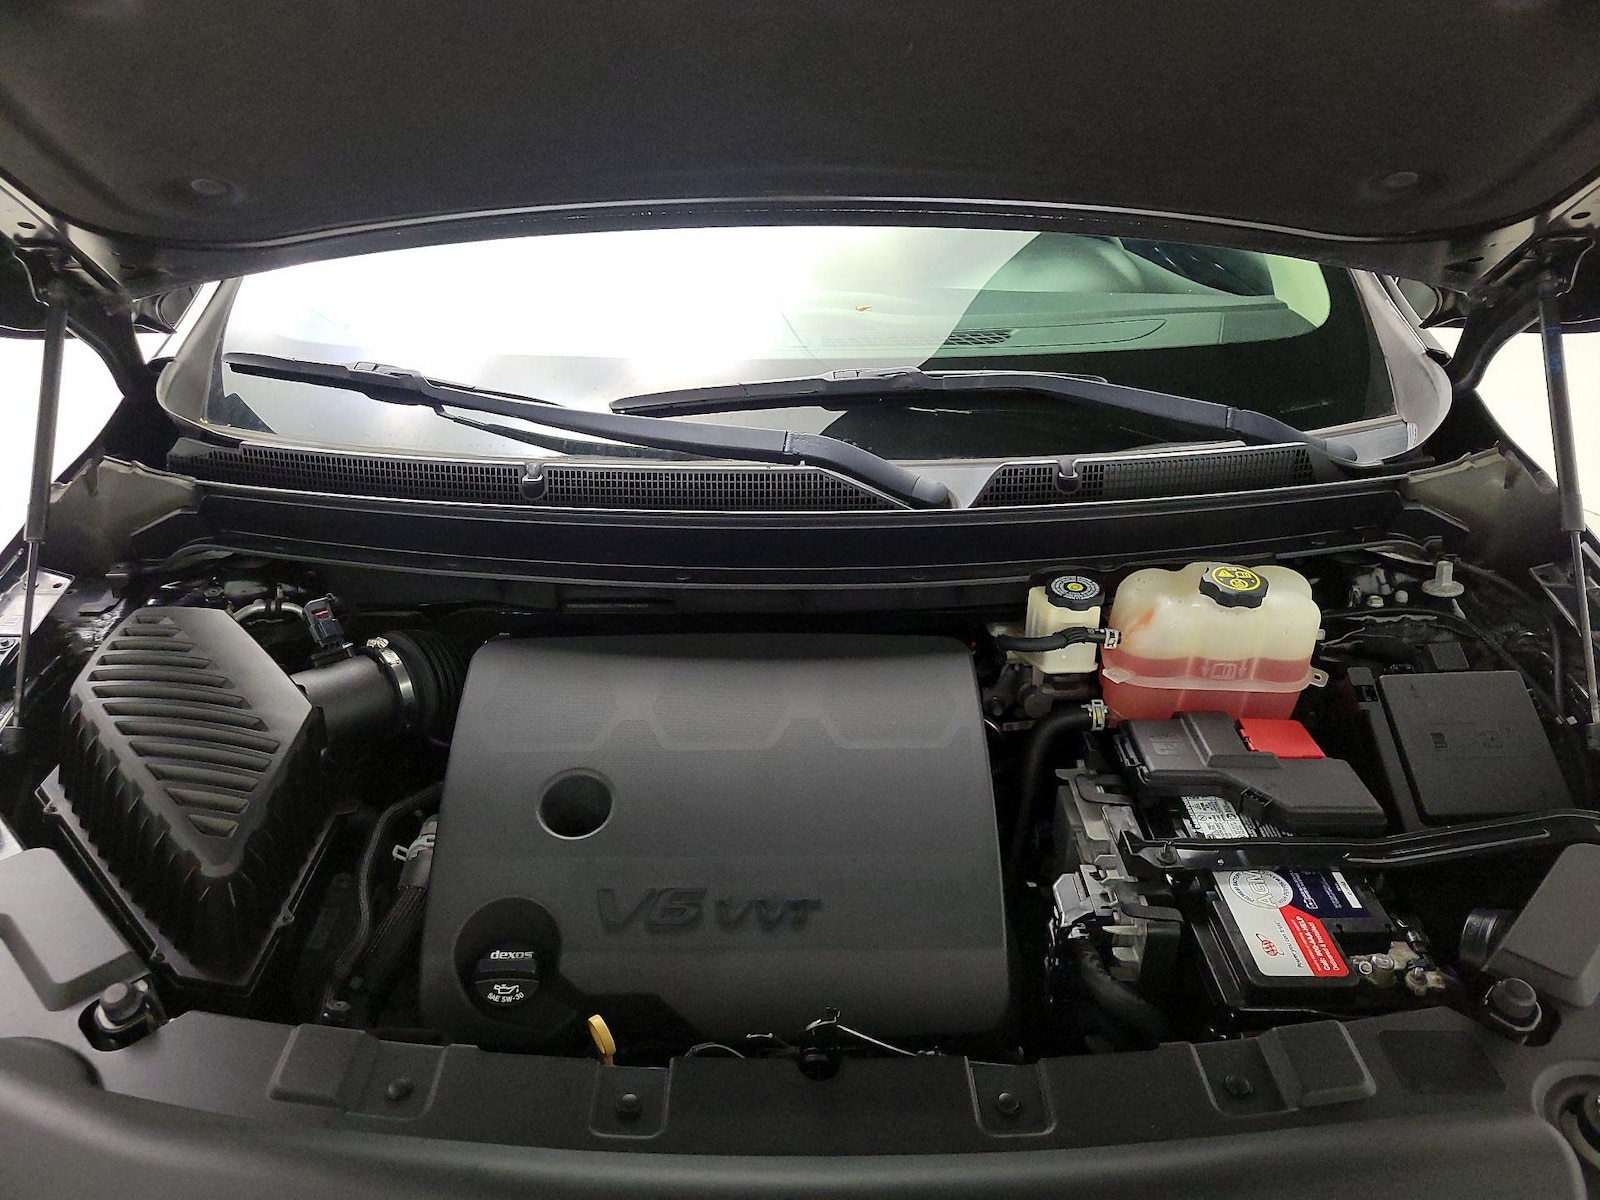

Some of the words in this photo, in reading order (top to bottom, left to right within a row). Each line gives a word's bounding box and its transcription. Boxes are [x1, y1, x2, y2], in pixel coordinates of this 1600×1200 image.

[1242, 870, 1277, 906] AGM
[597, 887, 707, 930] V6
[716, 898, 821, 931] VVT
[490, 949, 535, 960] dexos
[1319, 957, 1331, 971] Call:
[487, 992, 501, 1002] SAE
[501, 992, 525, 1003] 5W-30
